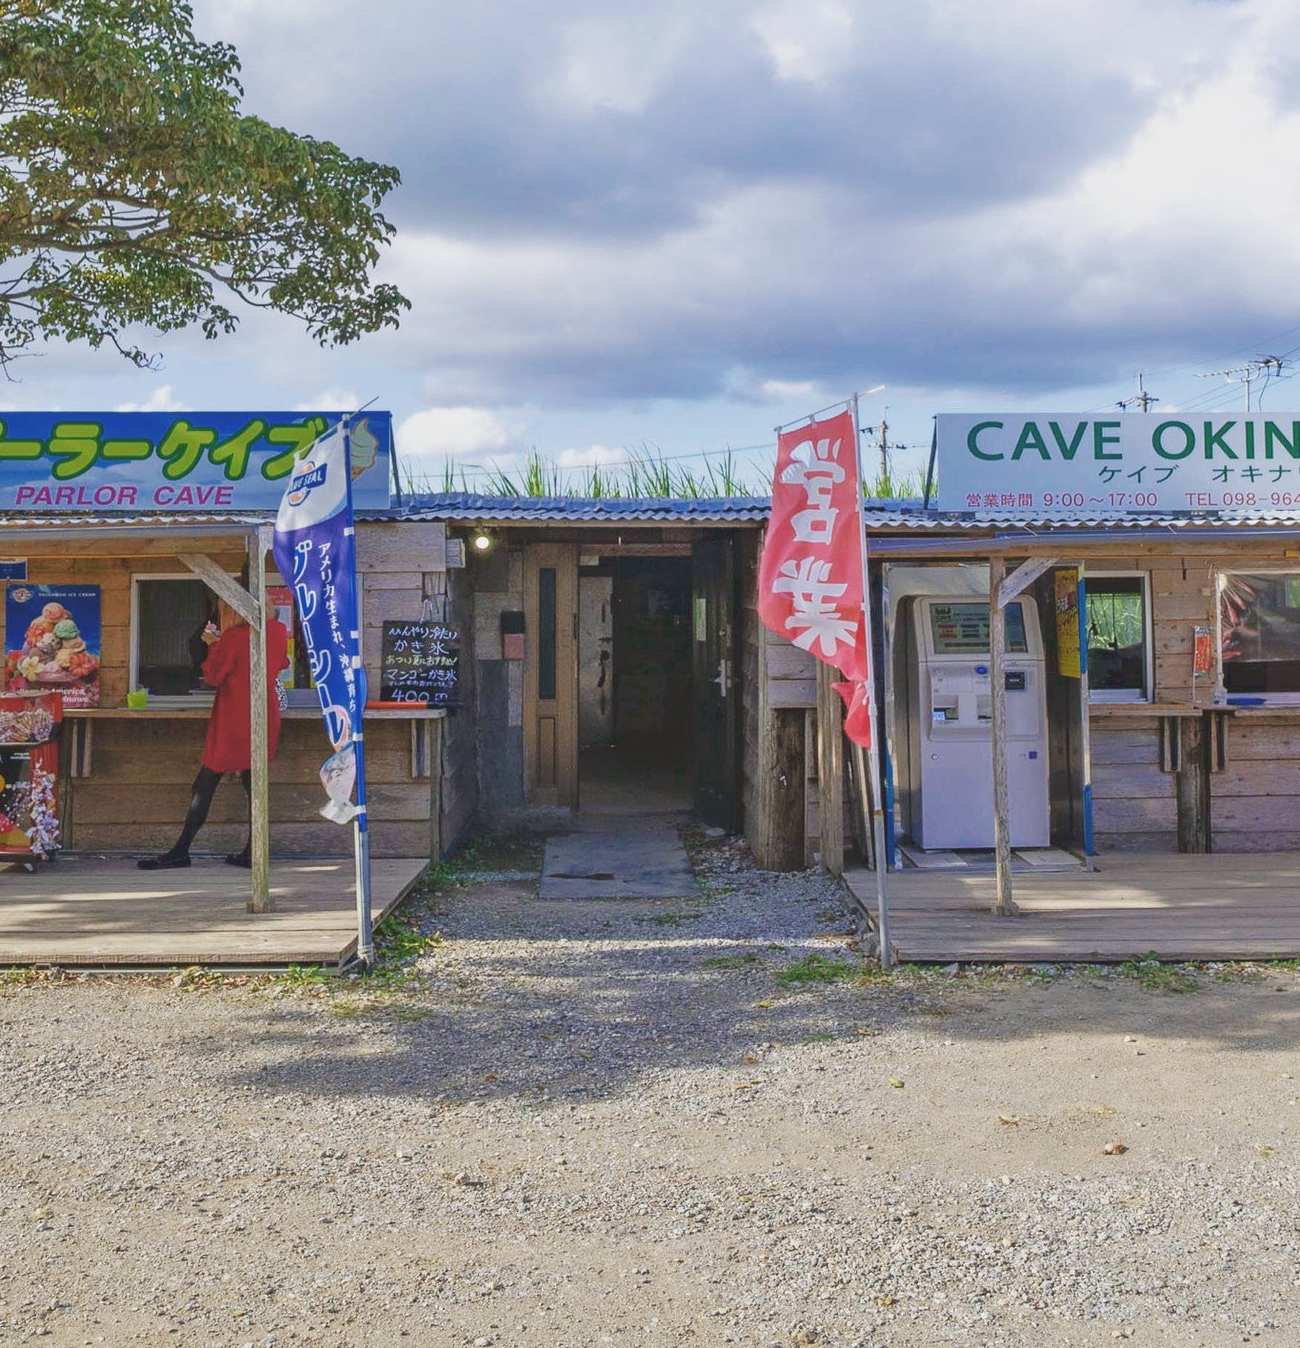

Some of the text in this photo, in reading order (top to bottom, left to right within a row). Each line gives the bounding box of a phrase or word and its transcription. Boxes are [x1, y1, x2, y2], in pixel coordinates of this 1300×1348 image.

[966, 421, 1123, 461] CAVE
[1098, 464, 1180, 484] ケイブ
[15, 485, 234, 506] PARLOR CAVE
[966, 493, 1033, 508] 営業時間
[1185, 492, 1218, 507] TEL
[394, 640, 449, 655] かき氷
